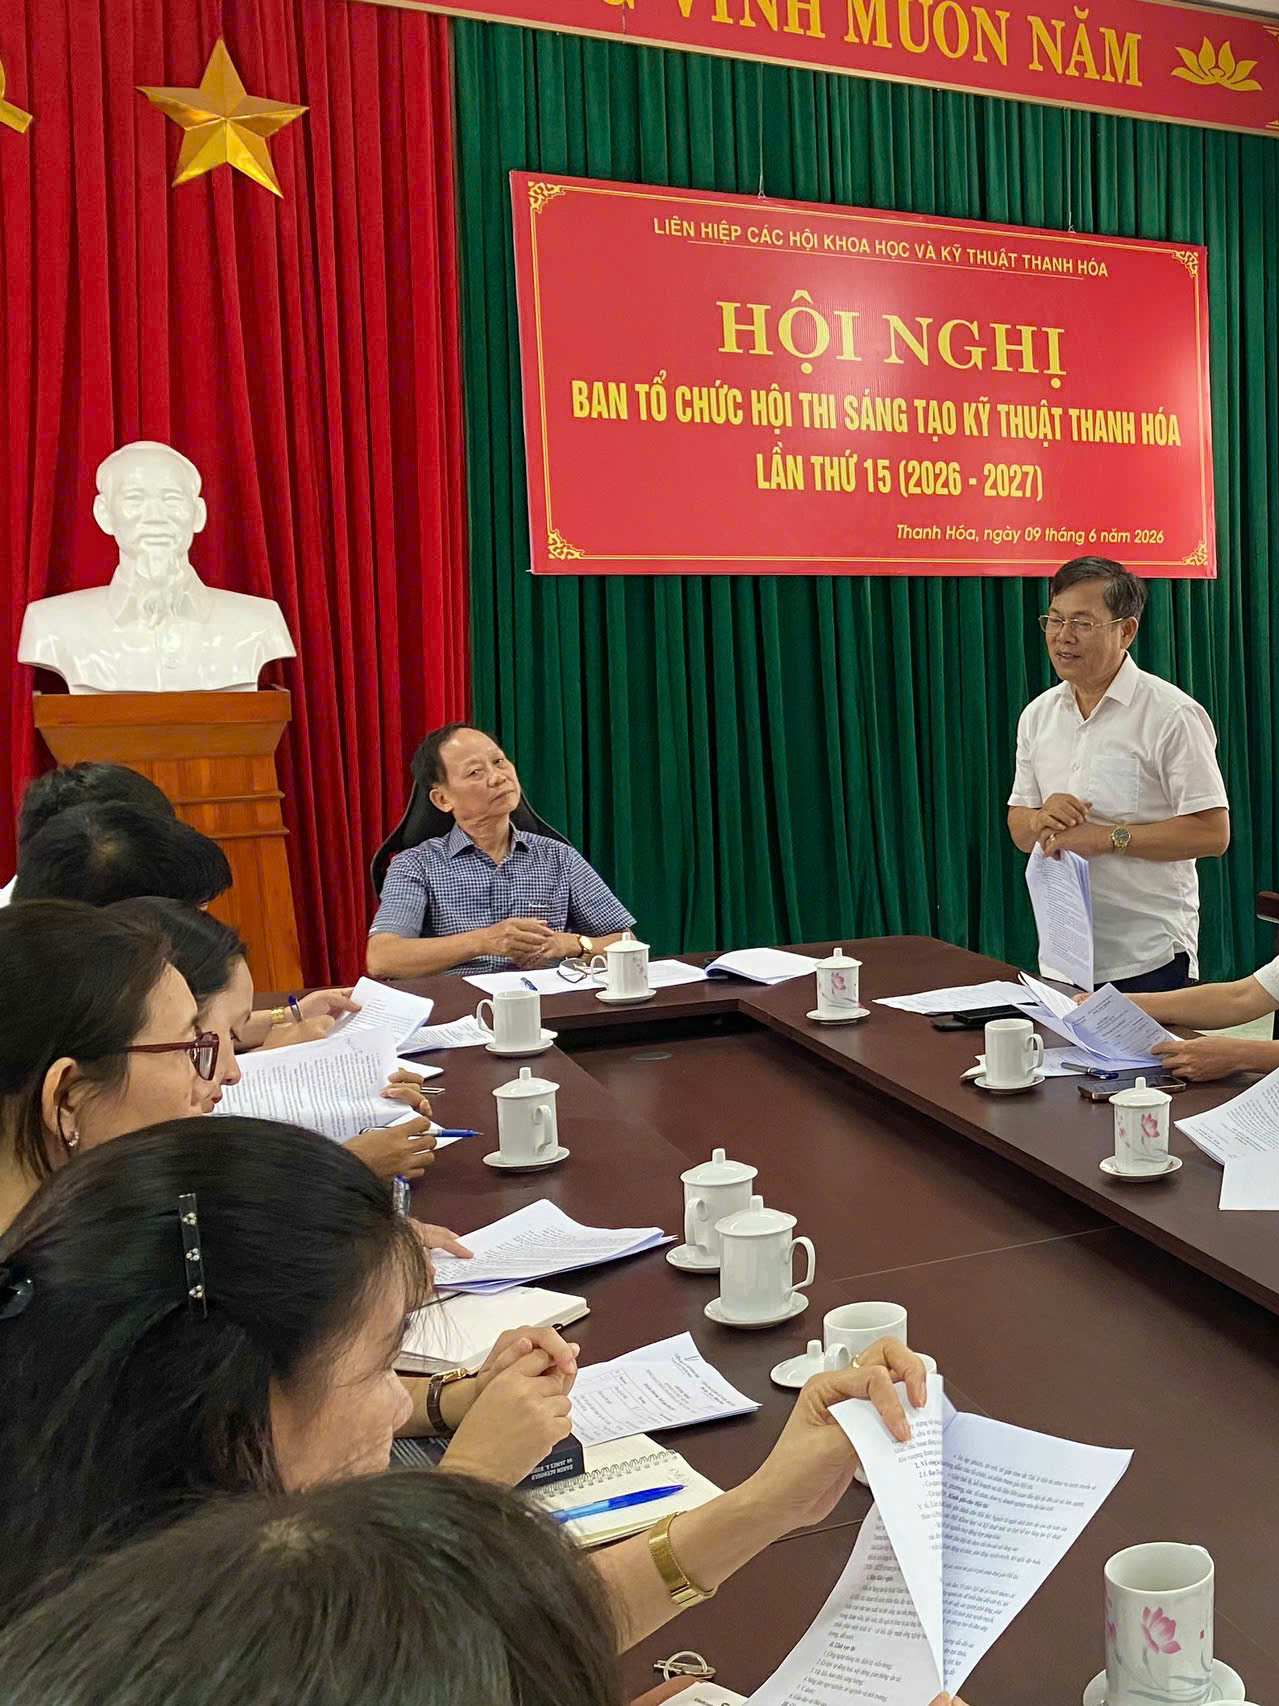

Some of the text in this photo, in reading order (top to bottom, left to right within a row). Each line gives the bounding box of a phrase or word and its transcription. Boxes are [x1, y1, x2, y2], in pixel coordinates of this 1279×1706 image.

[1026, 5, 1143, 87] NĂM
[653, 215, 1108, 277] LIÊN HIỆP CÁC HỘI KHOA HỌC VÀ KỸ THUẬT THANH HÓA
[715, 289, 1067, 389] HỘI NGHỊ
[571, 369, 1182, 448] BAN TỔ CHỨC HỘI THI SÁNG TẠO KỸ THUẬT THANH HÓA
[755, 441, 1044, 502] LẦN THỨ 15 (2026 - 2027)
[896, 524, 1165, 546] Thanh Hóa, ngày 09 tháng 6 năm 2026
